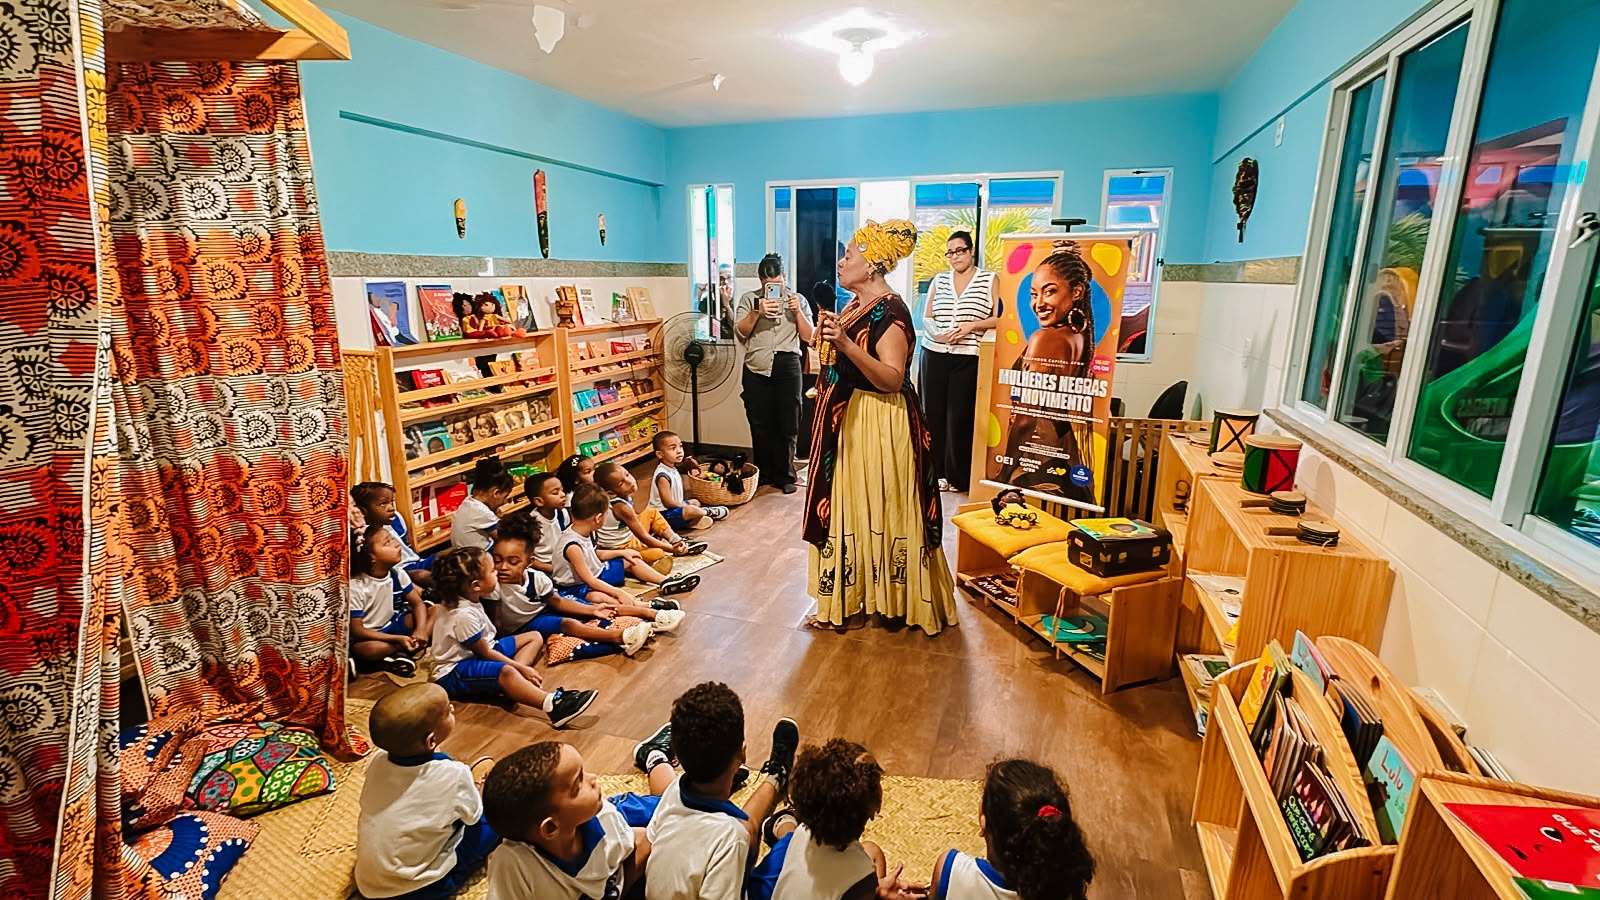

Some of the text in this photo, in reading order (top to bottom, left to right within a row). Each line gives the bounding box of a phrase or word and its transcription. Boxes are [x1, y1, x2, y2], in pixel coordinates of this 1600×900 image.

[998, 368, 1108, 398] MULHERES NEGRAS
[1021, 387, 1092, 413] MOVIMENTO
[995, 454, 1014, 466] OEI
[1380, 749, 1404, 791] Lulu
[1551, 813, 1588, 837] QUE
